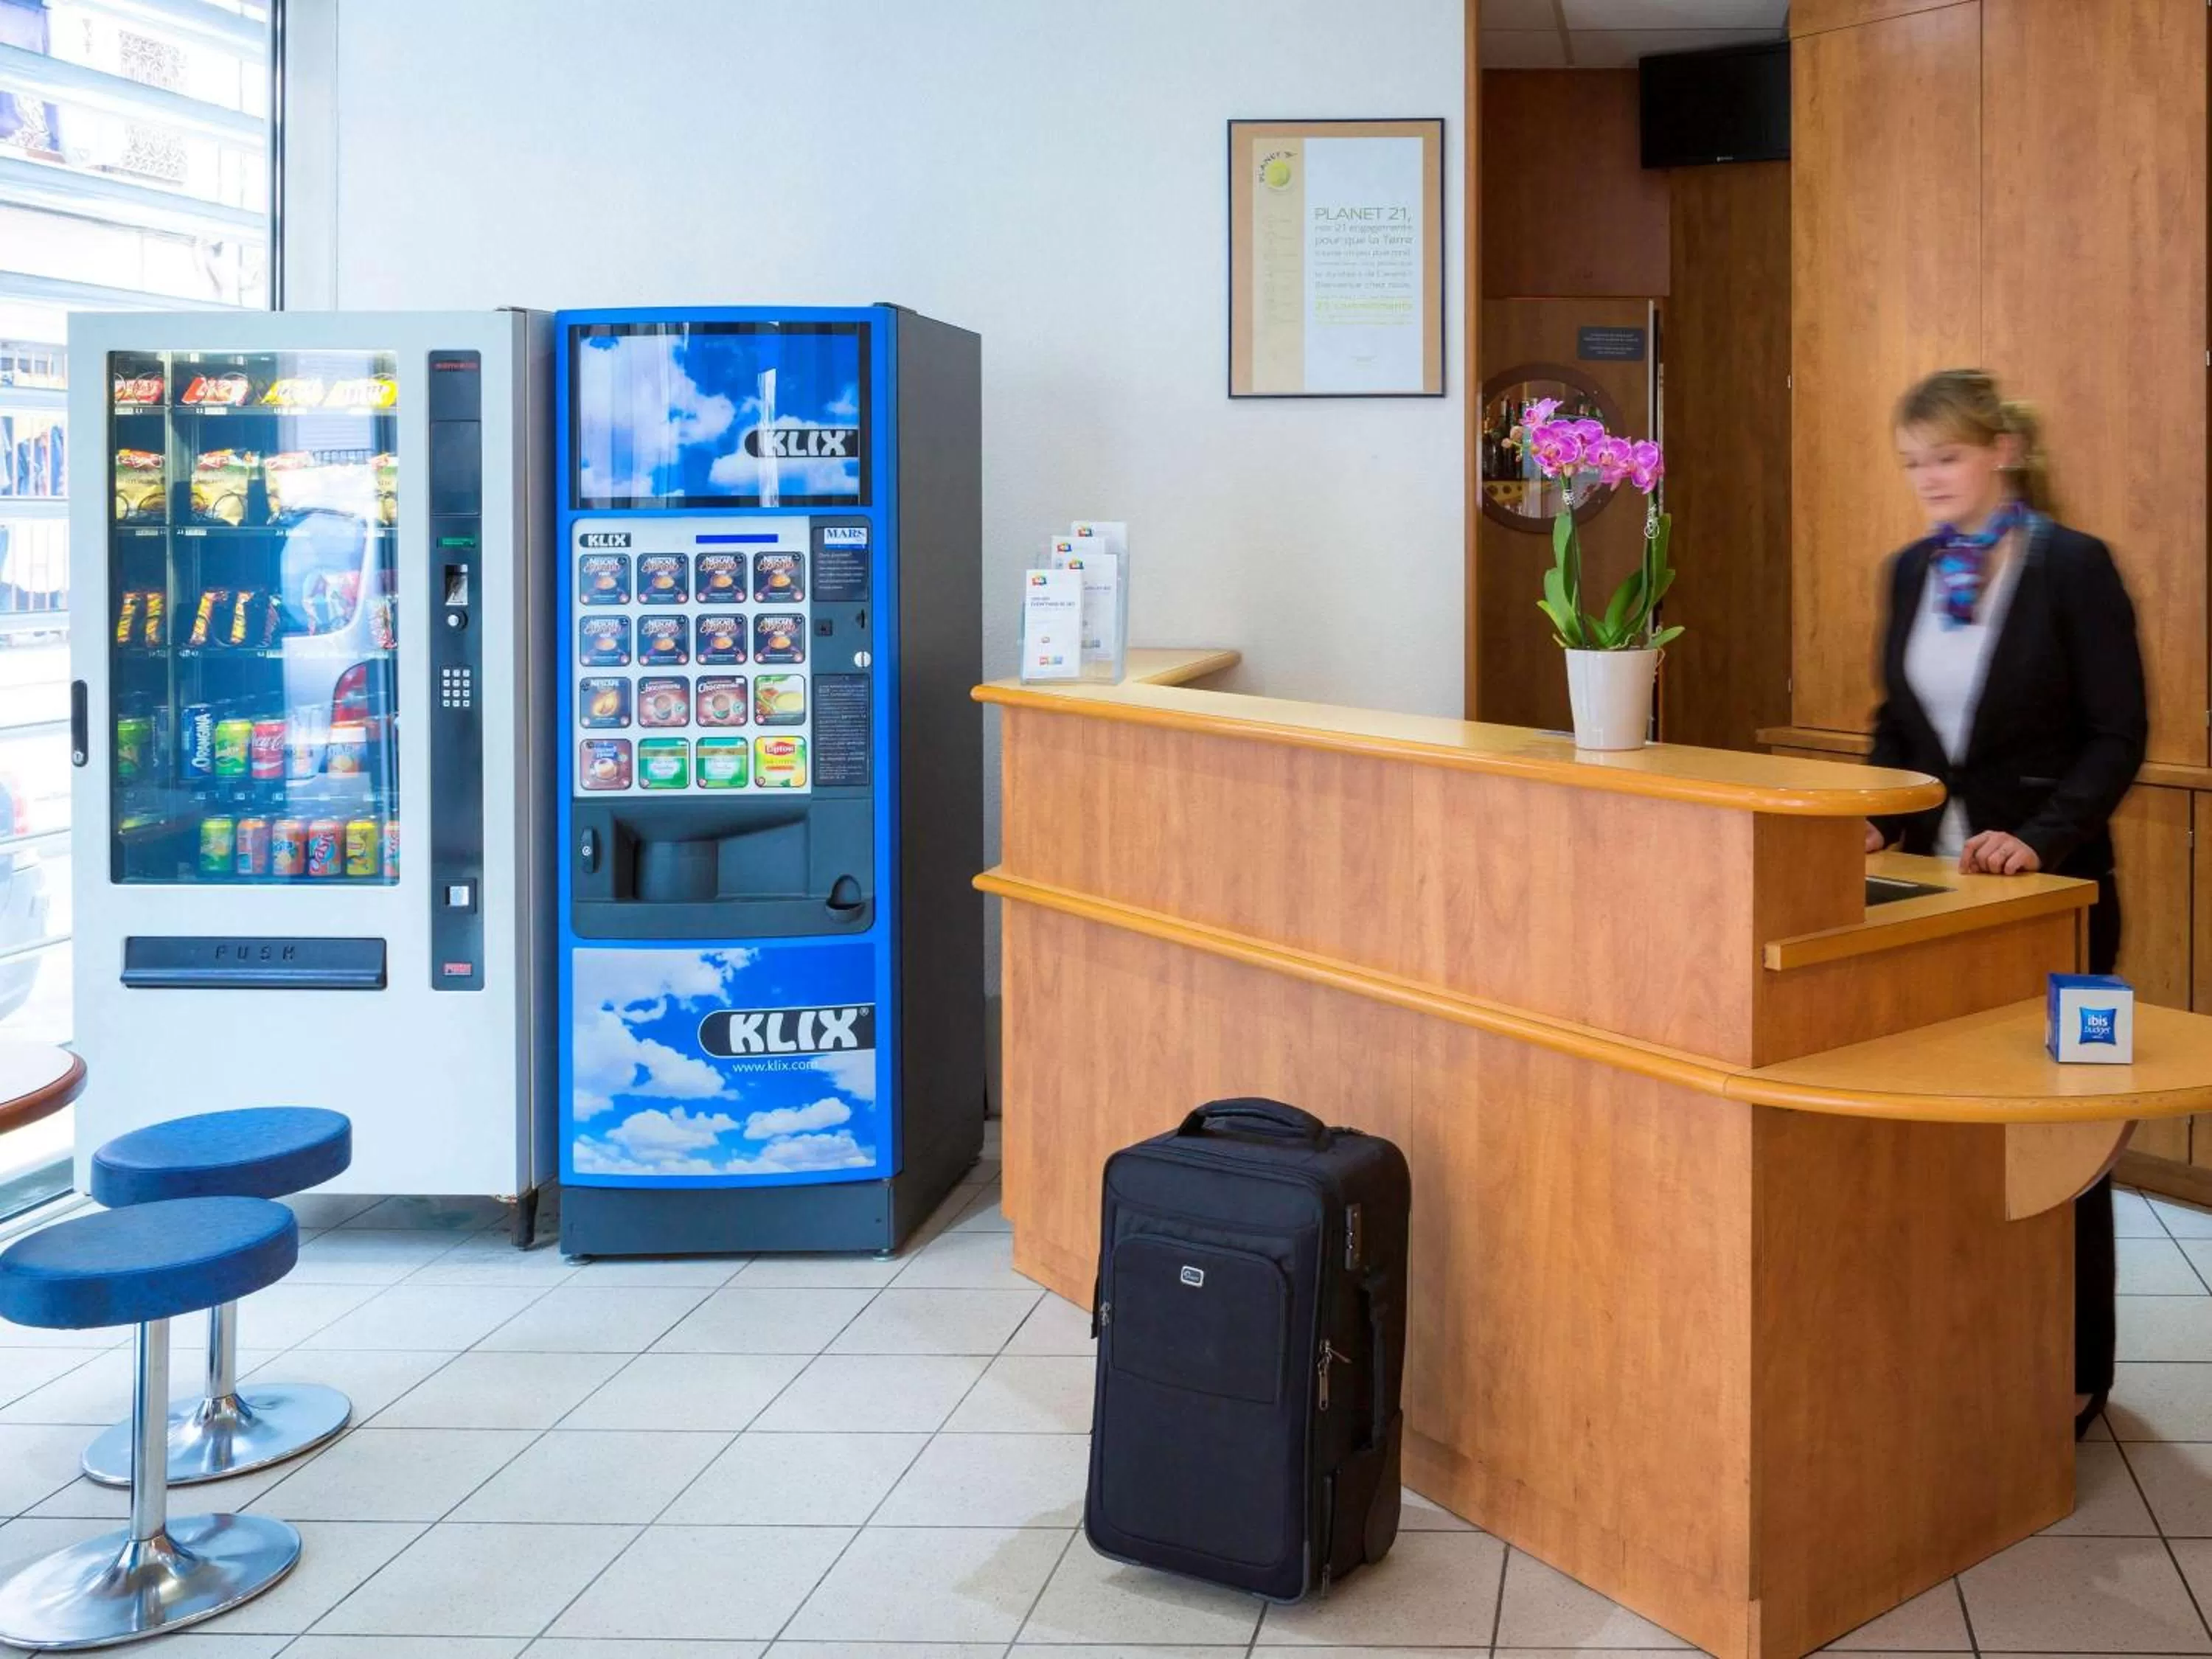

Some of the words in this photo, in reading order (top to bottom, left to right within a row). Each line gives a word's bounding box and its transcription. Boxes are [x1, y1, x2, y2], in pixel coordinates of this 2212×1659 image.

[1314, 207, 1383, 220] PLANET
[1388, 207, 1411, 223] 21,
[1315, 237, 1342, 248] pour
[762, 430, 846, 456] KLIX
[827, 529, 864, 539] MARS
[588, 535, 626, 546] KLIX
[767, 744, 794, 755] Lipton
[2087, 1014, 2108, 1026] ibis
[729, 1008, 858, 1054] KLIX
[2084, 1026, 2112, 1036] budget
[732, 1060, 819, 1073] www.klix.com
